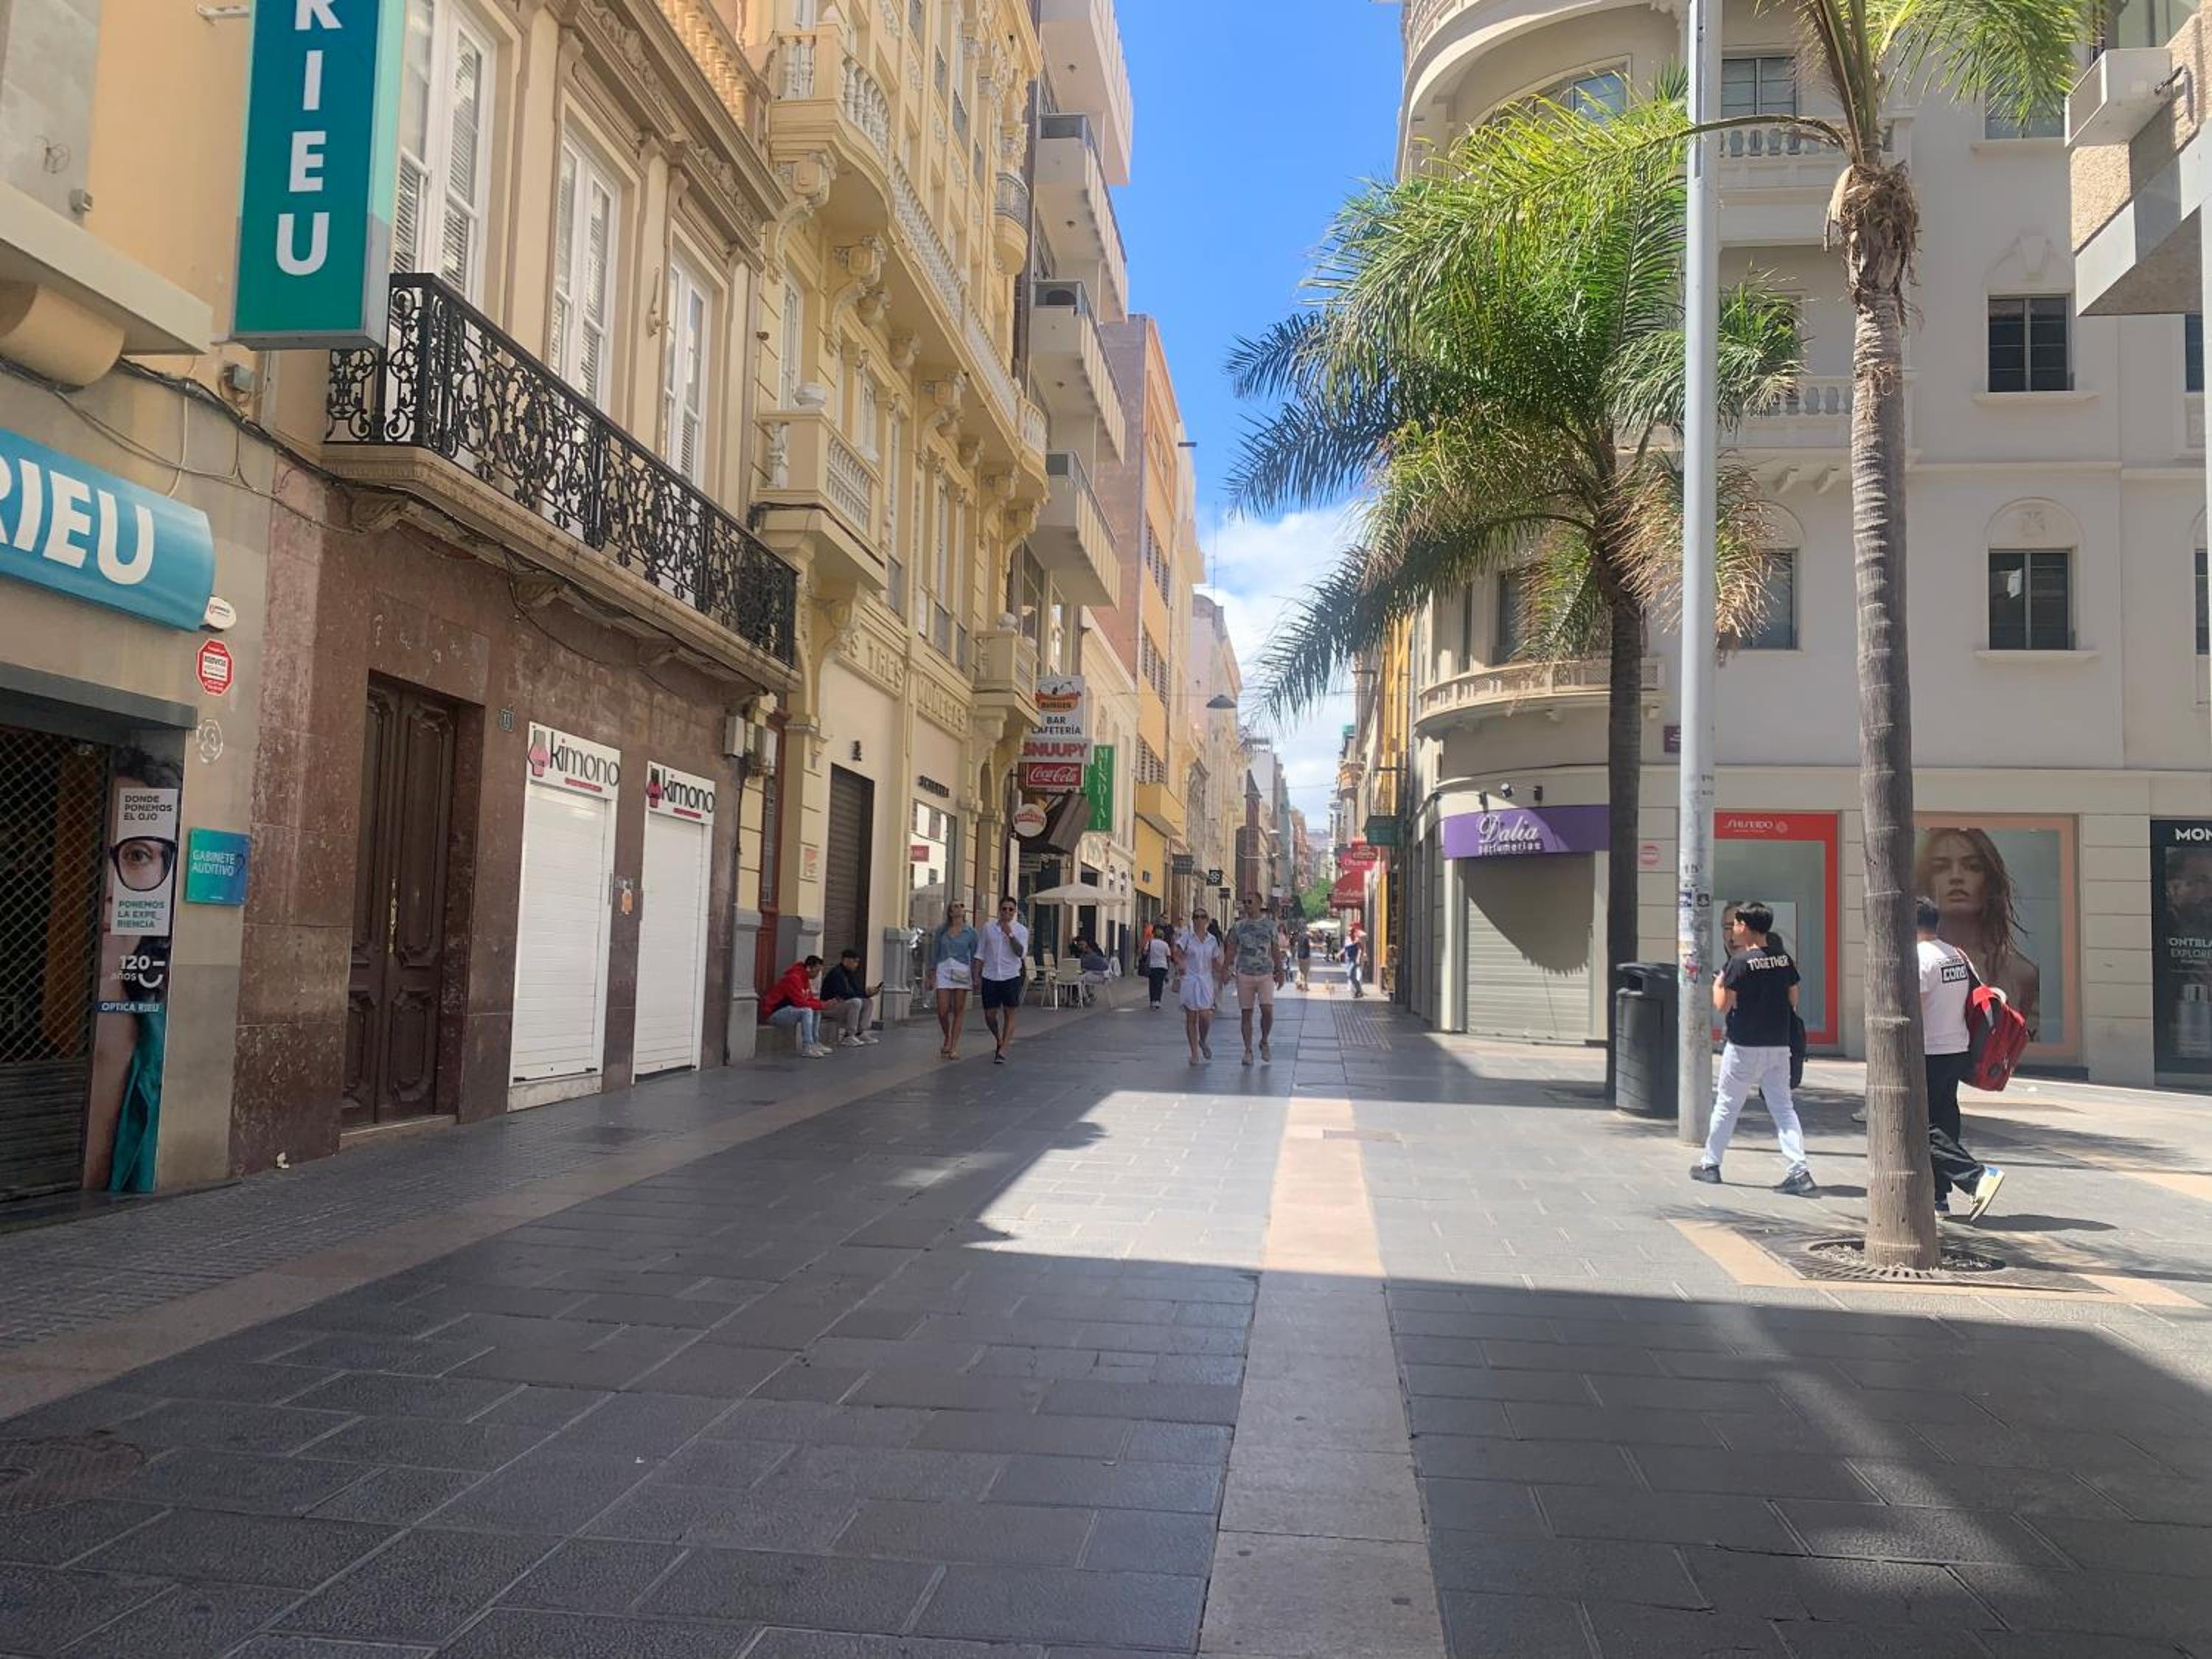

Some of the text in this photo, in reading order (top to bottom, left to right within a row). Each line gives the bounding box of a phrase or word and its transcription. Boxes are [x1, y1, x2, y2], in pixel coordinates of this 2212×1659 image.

[1046, 716, 1066, 724] BAR
[549, 731, 620, 787] kimono
[661, 768, 716, 813] kimono
[125, 795, 159, 803] DONDE
[123, 813, 158, 821] EL OJO
[1478, 813, 1538, 843] Dalia
[192, 849, 235, 865] GABINETE
[192, 862, 234, 877] AUDITIVO
[119, 900, 164, 909] PONEMOS
[117, 920, 156, 928] RIENCIA
[119, 955, 150, 970] 120
[1747, 955, 1789, 971] TOGETHER
